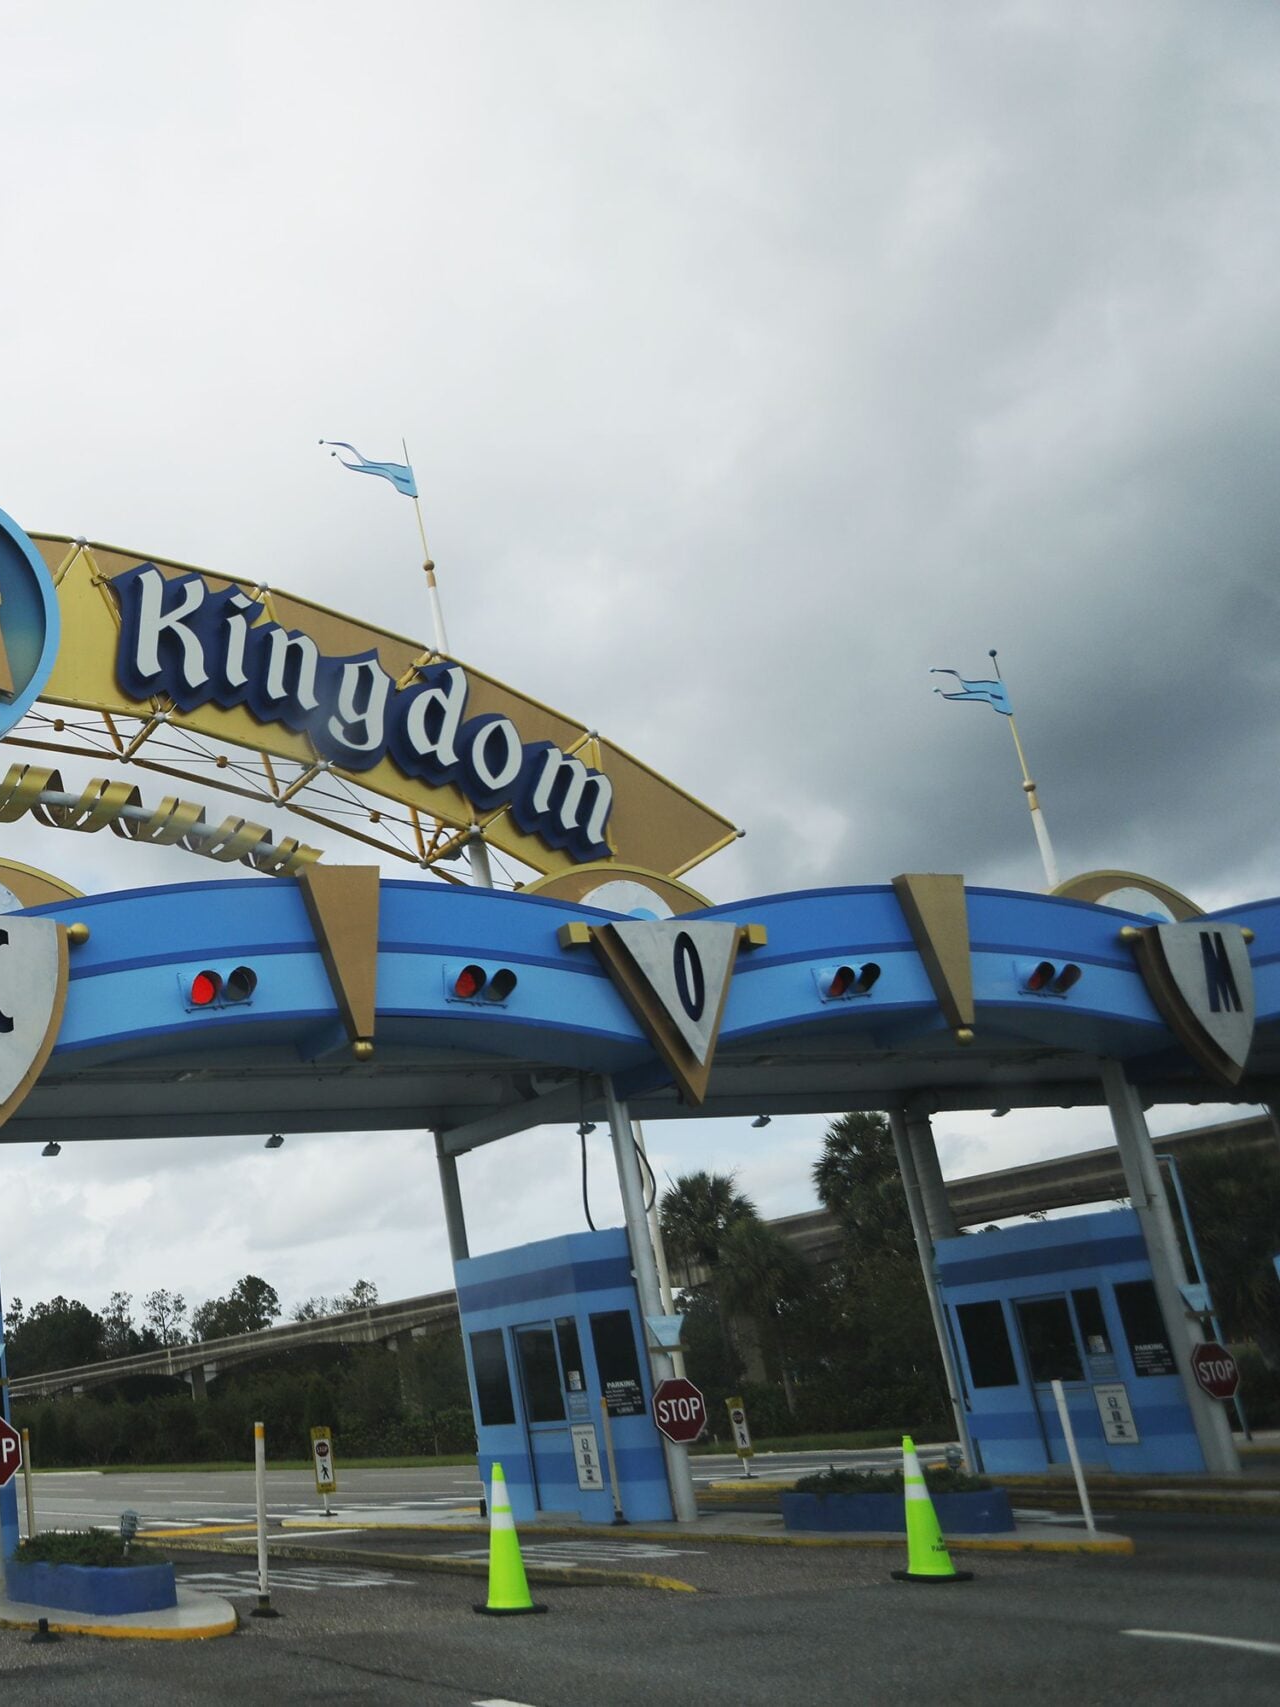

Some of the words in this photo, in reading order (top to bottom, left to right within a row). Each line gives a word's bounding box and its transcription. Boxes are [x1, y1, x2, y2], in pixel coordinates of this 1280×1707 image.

[133, 569, 613, 845] Kingdom
[1198, 1359, 1234, 1382] STOP
[658, 1397, 700, 1423] STOP
